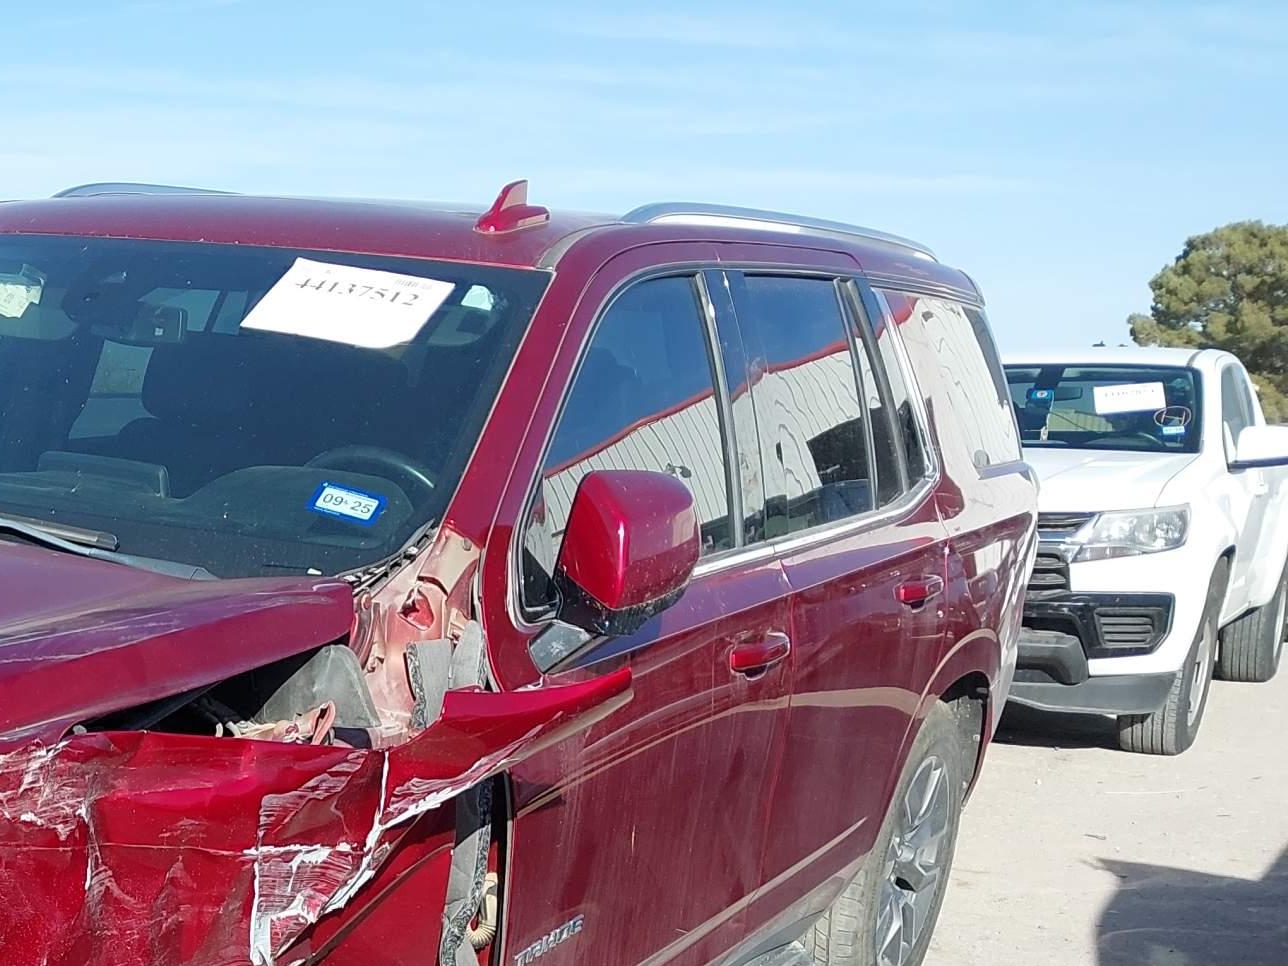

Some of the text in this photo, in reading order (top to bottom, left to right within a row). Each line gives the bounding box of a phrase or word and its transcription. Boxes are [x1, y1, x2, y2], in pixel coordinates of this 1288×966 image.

[296, 277, 420, 307] 44137512
[322, 493, 344, 506] 09
[350, 500, 373, 514] 25
